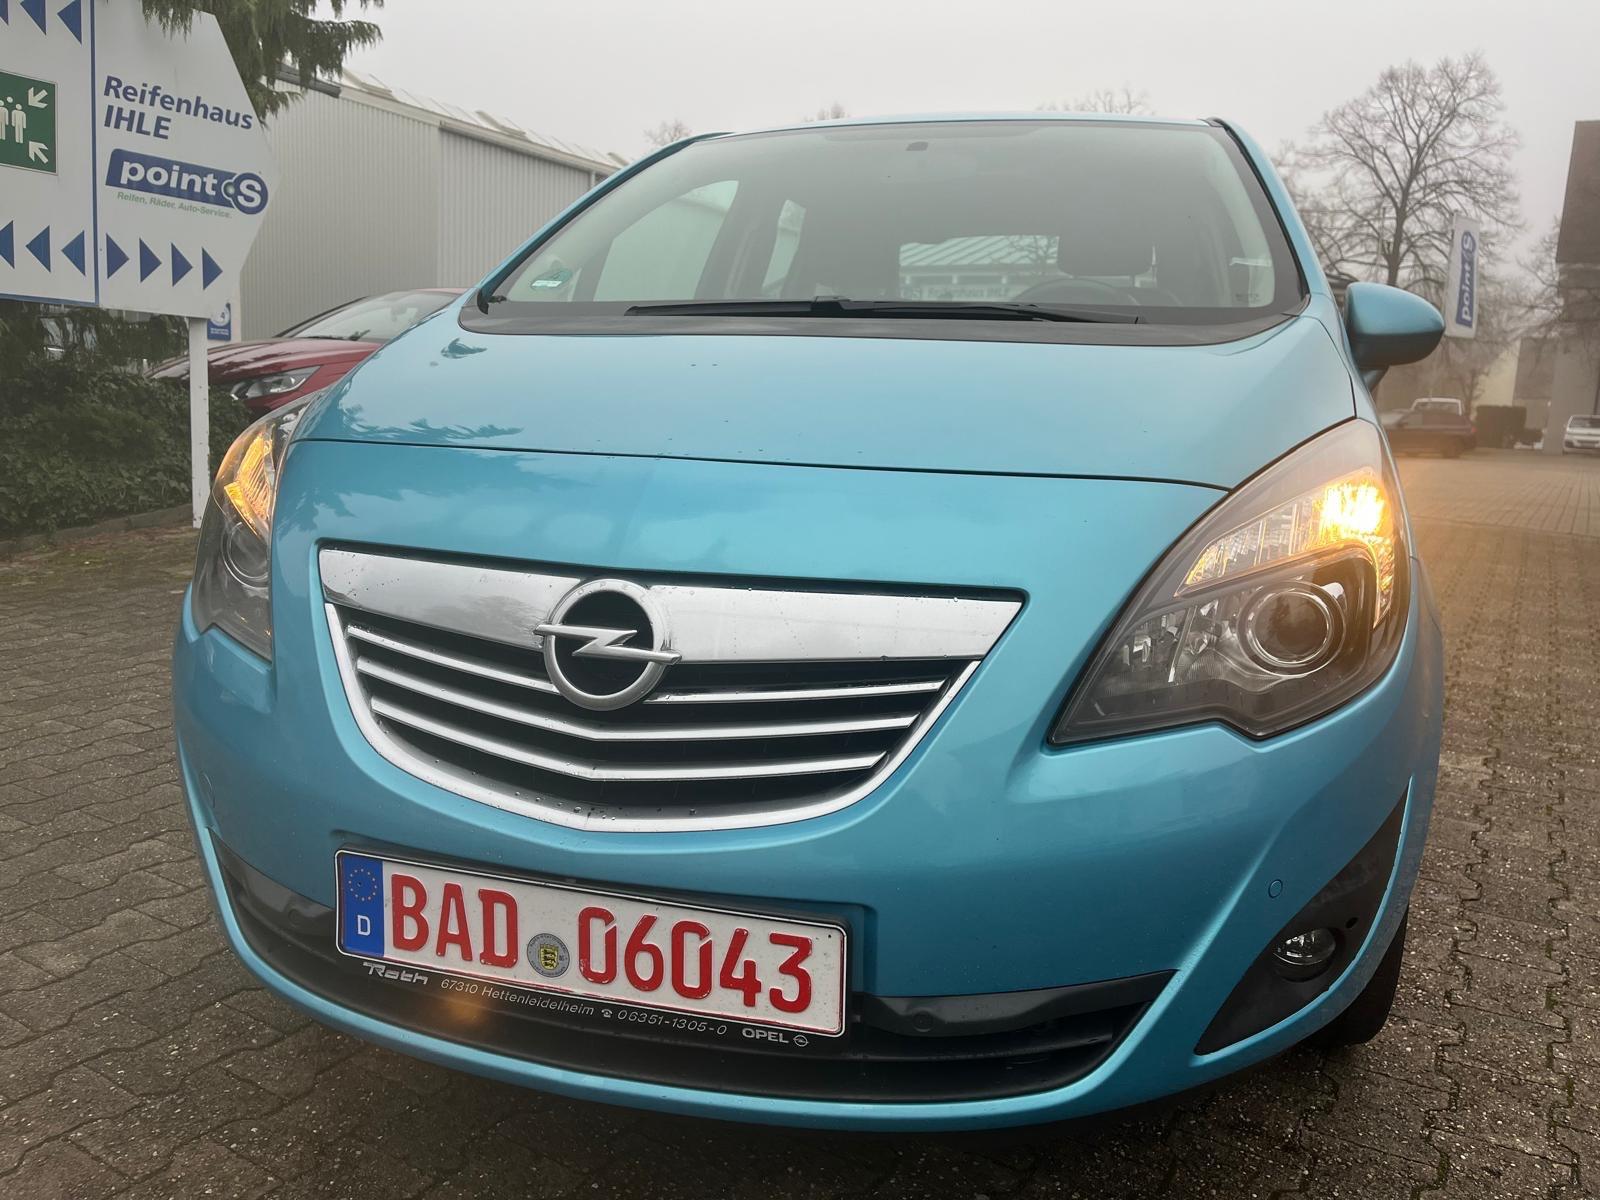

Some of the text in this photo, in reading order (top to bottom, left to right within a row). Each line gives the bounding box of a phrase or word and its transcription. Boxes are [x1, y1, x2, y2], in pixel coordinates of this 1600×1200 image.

[103, 75, 253, 130] Reifenhaus
[103, 105, 172, 140] IHLE
[117, 191, 148, 205] Reifen,
[119, 160, 262, 209] point S
[1461, 261, 1473, 322] point
[357, 914, 371, 936] D
[391, 873, 519, 969] BAD
[578, 906, 813, 1014] 06043
[362, 961, 429, 985] Roth
[440, 979, 479, 995] 67310
[481, 985, 595, 1016] Hettenleidelheim
[742, 1027, 790, 1045] OPEL
